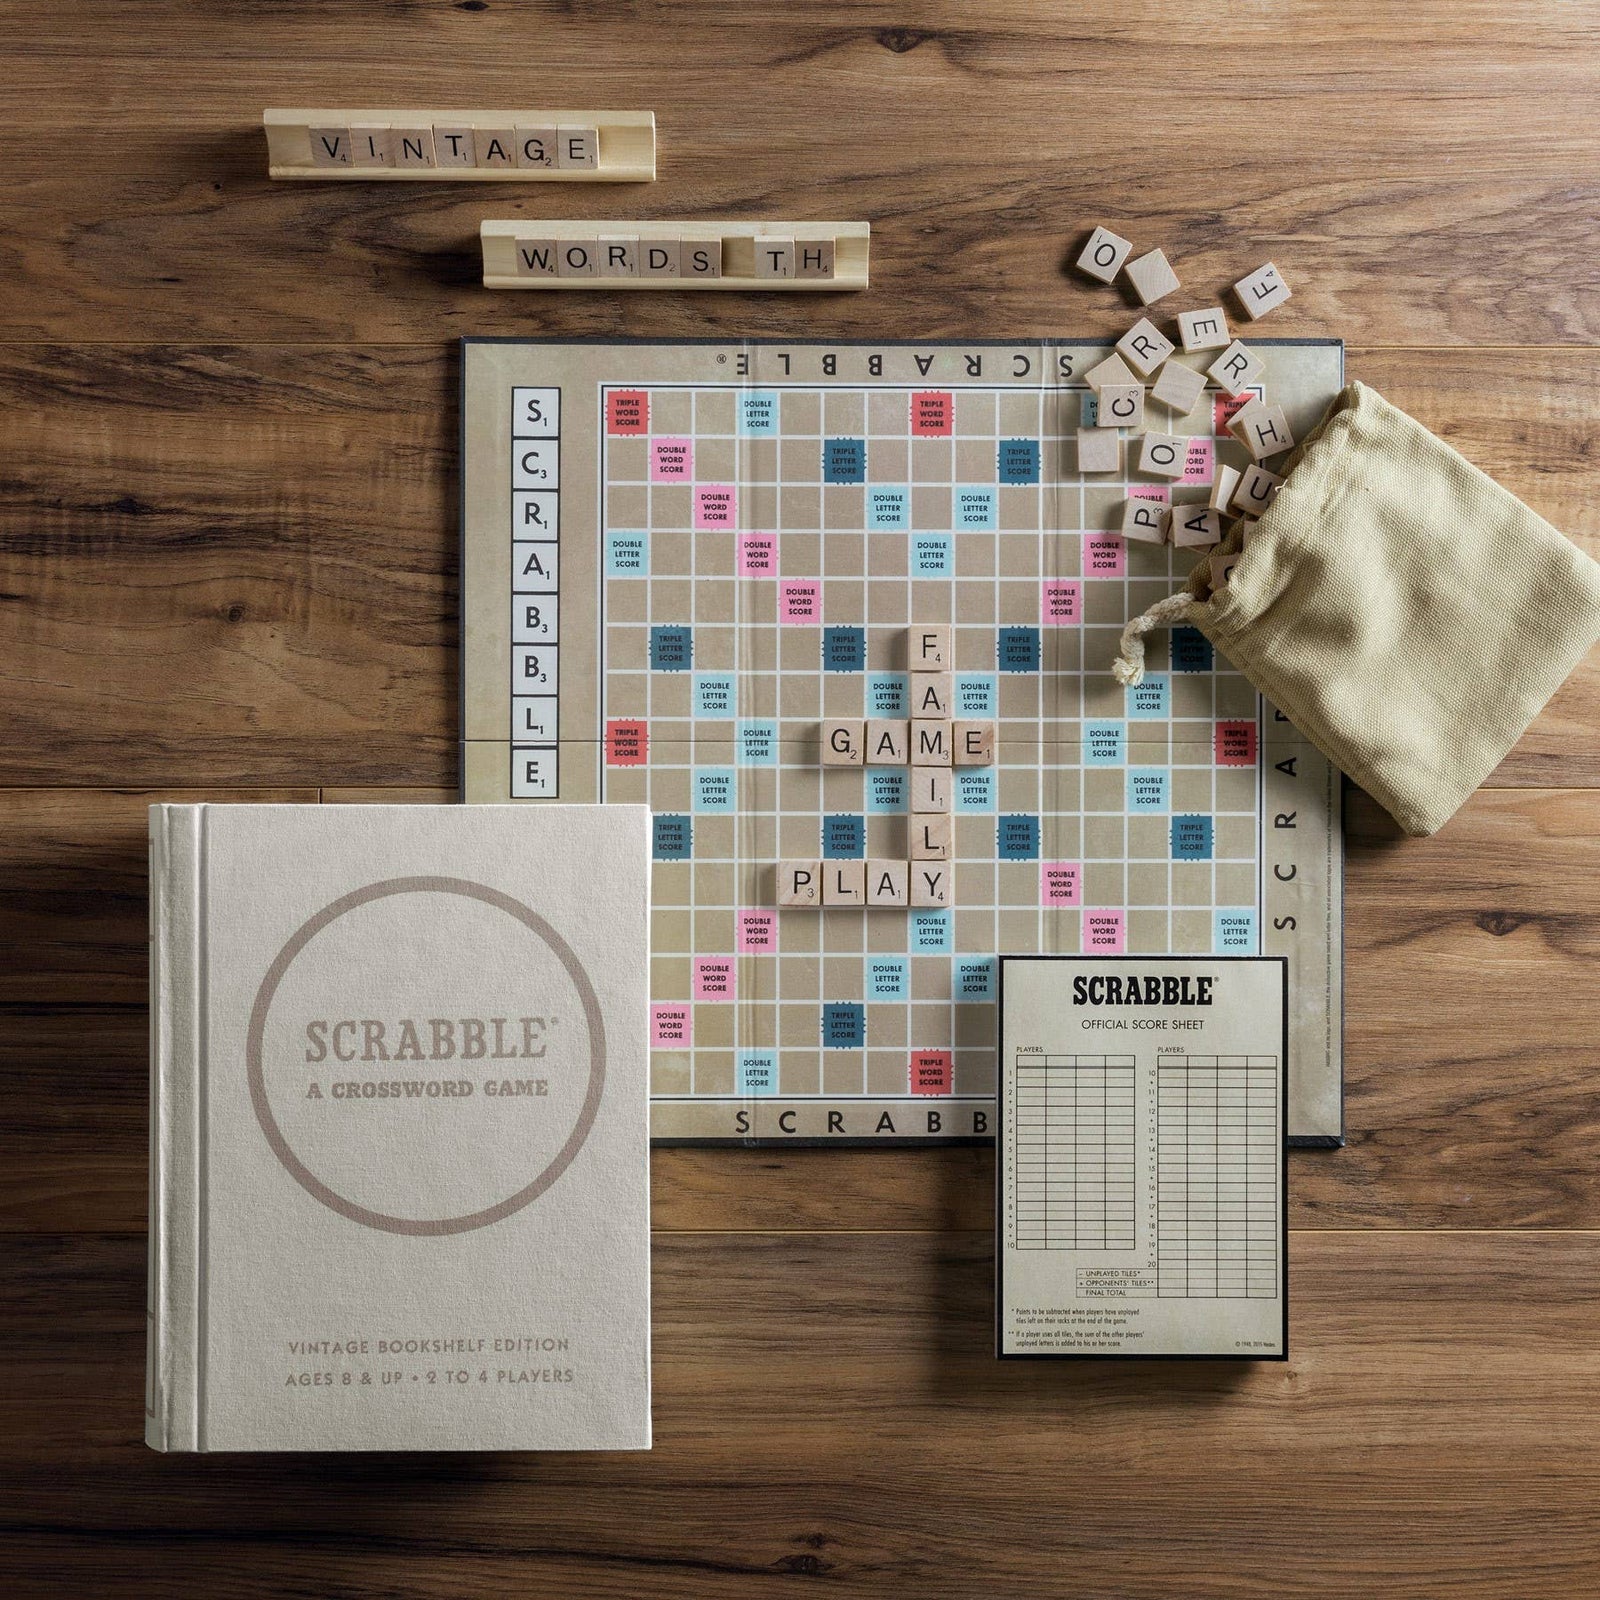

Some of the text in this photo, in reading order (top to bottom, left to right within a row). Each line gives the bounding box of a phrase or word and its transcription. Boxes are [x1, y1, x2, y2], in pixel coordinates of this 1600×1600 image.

[321, 133, 595, 167] VINTAGE
[522, 246, 829, 275] WORDS TH
[615, 399, 640, 407] TRIPLE
[744, 400, 772, 408] DOUBLE
[919, 400, 944, 408] TRIPLE
[615, 409, 640, 417] WORD
[746, 410, 770, 418] LETTER
[919, 410, 944, 418] WORD
[615, 418, 640, 426] SCORE
[746, 420, 769, 428] SCORE
[919, 420, 944, 428] SCORE
[657, 446, 687, 454] DOUBLE
[1007, 448, 1031, 456] TRIPLE
[659, 456, 684, 464] WORD
[1006, 458, 1032, 466] LETTER
[659, 465, 684, 473] SCORE
[1007, 467, 1031, 475] SCORE
[700, 493, 730, 501] DOUBLE
[960, 495, 991, 503] DOUBLE
[703, 503, 728, 511] WORD
[963, 504, 988, 512] LETTER
[703, 513, 727, 521] SCORE
[612, 540, 643, 548] DOUBLE
[1090, 541, 1120, 550] DOUBLE
[614, 550, 640, 558] LETTER
[1092, 551, 1117, 559] WORD
[615, 560, 640, 568] SCORE
[1092, 561, 1117, 569] SCORE
[786, 588, 815, 596] DOUBLE
[788, 598, 813, 606] WORD
[788, 608, 813, 616] SCORE
[700, 682, 730, 690] DOUBLE
[702, 692, 727, 700] LETTER
[702, 702, 727, 710] SCORE
[614, 728, 639, 736] TRIPLE
[1224, 729, 1248, 738] TRIPLE
[614, 738, 639, 746] WORD
[830, 728, 990, 761] GAME
[1223, 739, 1249, 747] WORD
[614, 749, 639, 757] SCORE
[1092, 749, 1117, 757] SCORE
[1223, 748, 1249, 757] SCORE
[1179, 833, 1204, 841] LETTER
[1179, 843, 1204, 851] SCORE
[793, 870, 945, 902] PLAY
[743, 917, 771, 925] DOUBLE
[1220, 918, 1251, 926] DOUBLE
[746, 927, 769, 935] WORD
[1223, 928, 1248, 936] LETTER
[745, 937, 769, 945] SCORE
[960, 964, 991, 973] DOUBLE
[962, 975, 988, 983] LETTER
[963, 985, 988, 993] SCORE
[831, 1012, 855, 1020] TRIPLE
[830, 1021, 856, 1029] LETTER
[1081, 1019, 1205, 1030] OFFICIAL SCORE SHEET
[831, 1031, 856, 1039] SCORE
[1157, 1046, 1185, 1054] PLAYERS
[743, 1059, 772, 1067] DOUBLE
[919, 1058, 944, 1066] TRIPLE
[745, 1069, 769, 1077] LETTER
[918, 1068, 943, 1076] WORD
[746, 1079, 769, 1087] SCORE
[918, 1078, 944, 1086] SCORE
[305, 1079, 549, 1100] A CROSSWORD GAME
[288, 1338, 570, 1355] VINTAGE BOOKSHELF EDITION
[285, 1369, 574, 1387] AGES 8 & UP 2 TO 4 PLAYERS
